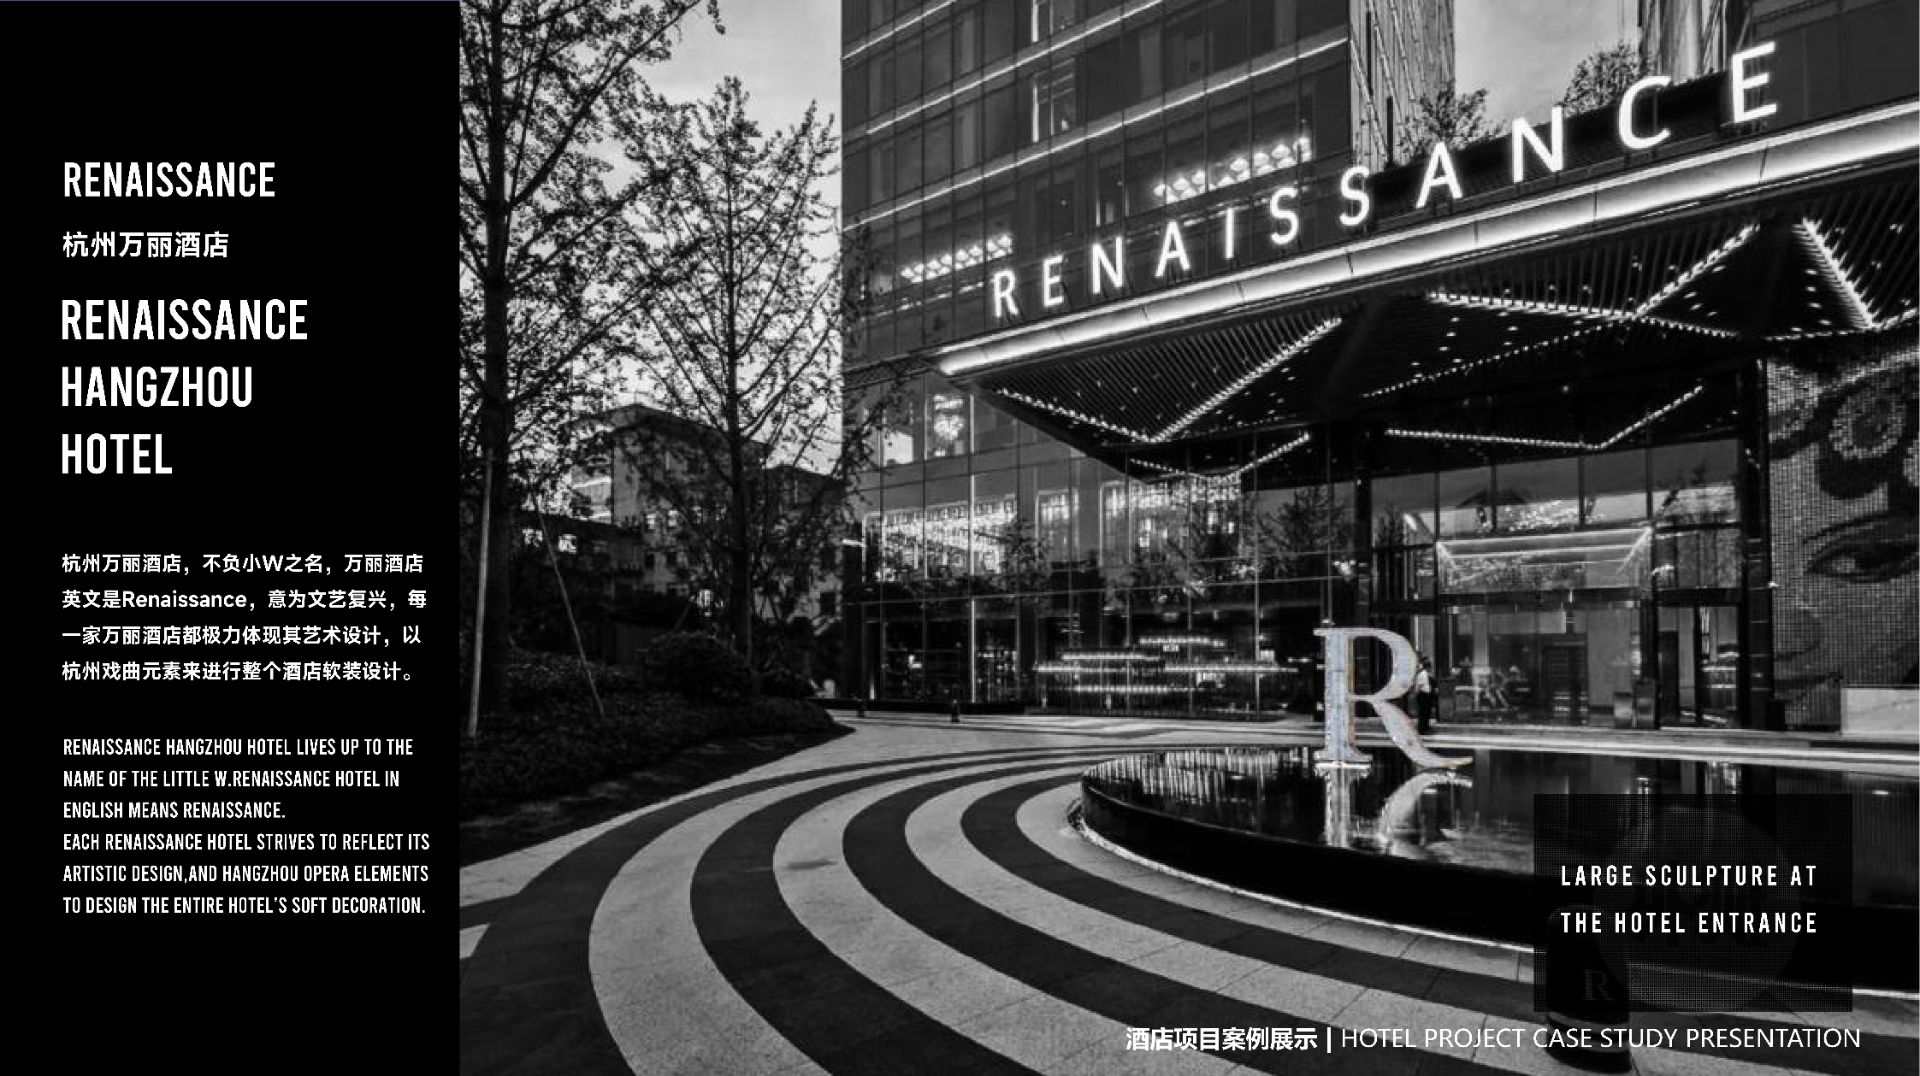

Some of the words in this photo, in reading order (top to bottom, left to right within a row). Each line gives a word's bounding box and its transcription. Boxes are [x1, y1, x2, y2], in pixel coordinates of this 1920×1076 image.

[991, 41, 1778, 318] RENAISSANCE
[1313, 628, 1473, 768] R
[1583, 968, 1615, 1001] R
